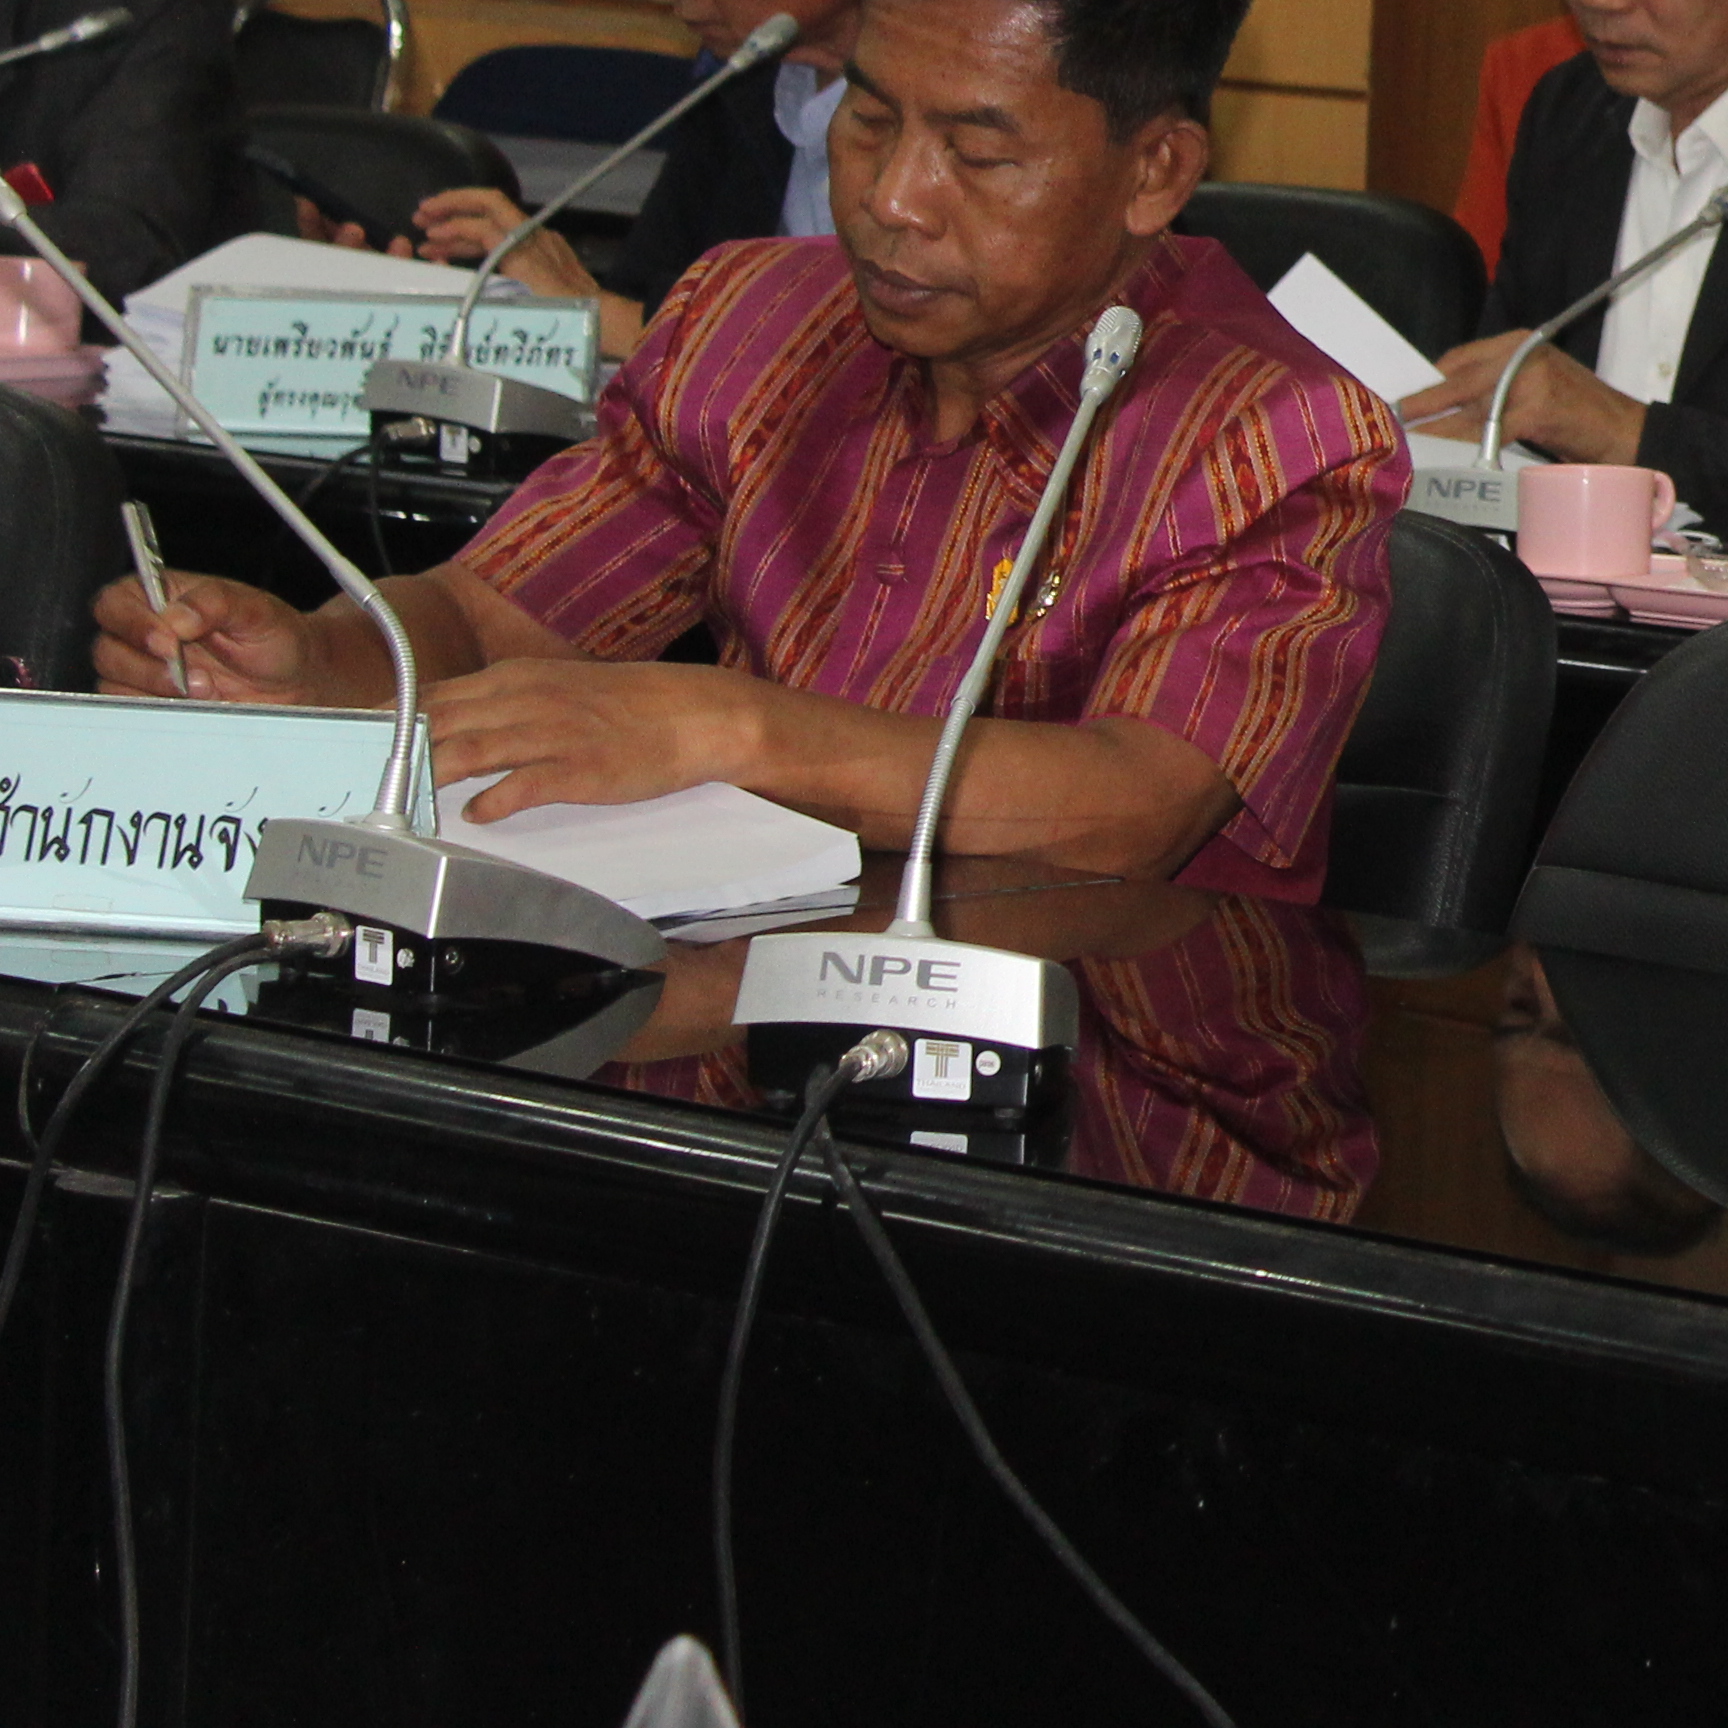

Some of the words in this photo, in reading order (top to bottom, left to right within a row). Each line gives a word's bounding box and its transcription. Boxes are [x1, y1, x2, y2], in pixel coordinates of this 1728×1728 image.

[1426, 476, 1503, 502] NPE
[297, 834, 388, 879] NPE
[819, 951, 961, 993] NPE
[816, 989, 957, 1010] RESEARCH
